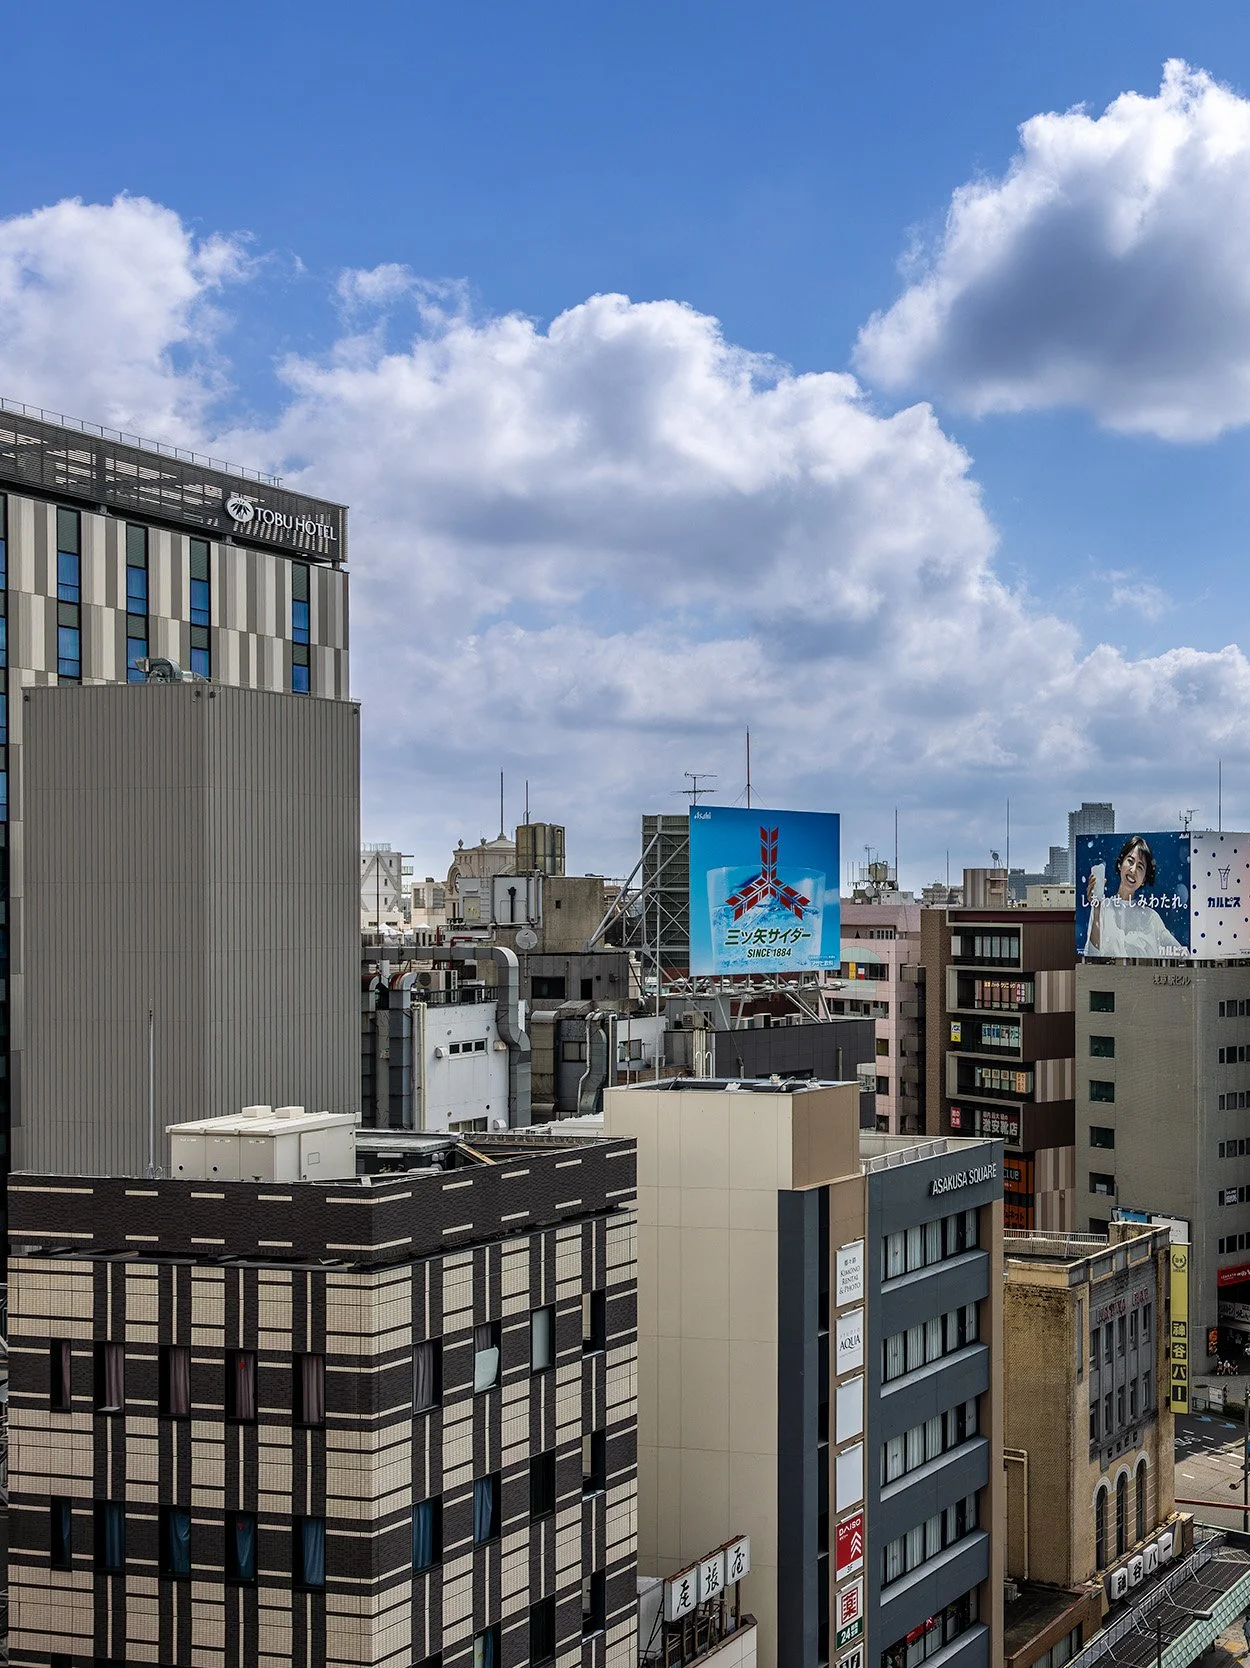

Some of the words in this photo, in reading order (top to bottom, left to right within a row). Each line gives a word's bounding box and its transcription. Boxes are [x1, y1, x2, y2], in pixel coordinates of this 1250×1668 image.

[256, 507, 292, 529] TOBU
[296, 517, 337, 541] HOTEL
[694, 811, 711, 820] Asahi
[1081, 894, 1188, 910] しあわせ、しみわたれ。
[1207, 896, 1241, 908] カルピス
[725, 928, 811, 945] 三ツ矢サイダー
[747, 948, 771, 958] SINCE
[772, 948, 792, 957] 1884
[1158, 945, 1189, 957] カルピス
[932, 1172, 968, 1195] ASAKUSA
[968, 1163, 997, 1184] SQUARE
[840, 1334, 861, 1351] AQUA
[1172, 1322, 1186, 1401] 神谷バー
[838, 1518, 861, 1536] DAISO
[1118, 1543, 1171, 1594] 神谷バー
[843, 1591, 858, 1622] 薬
[841, 1627, 851, 1644] 24
